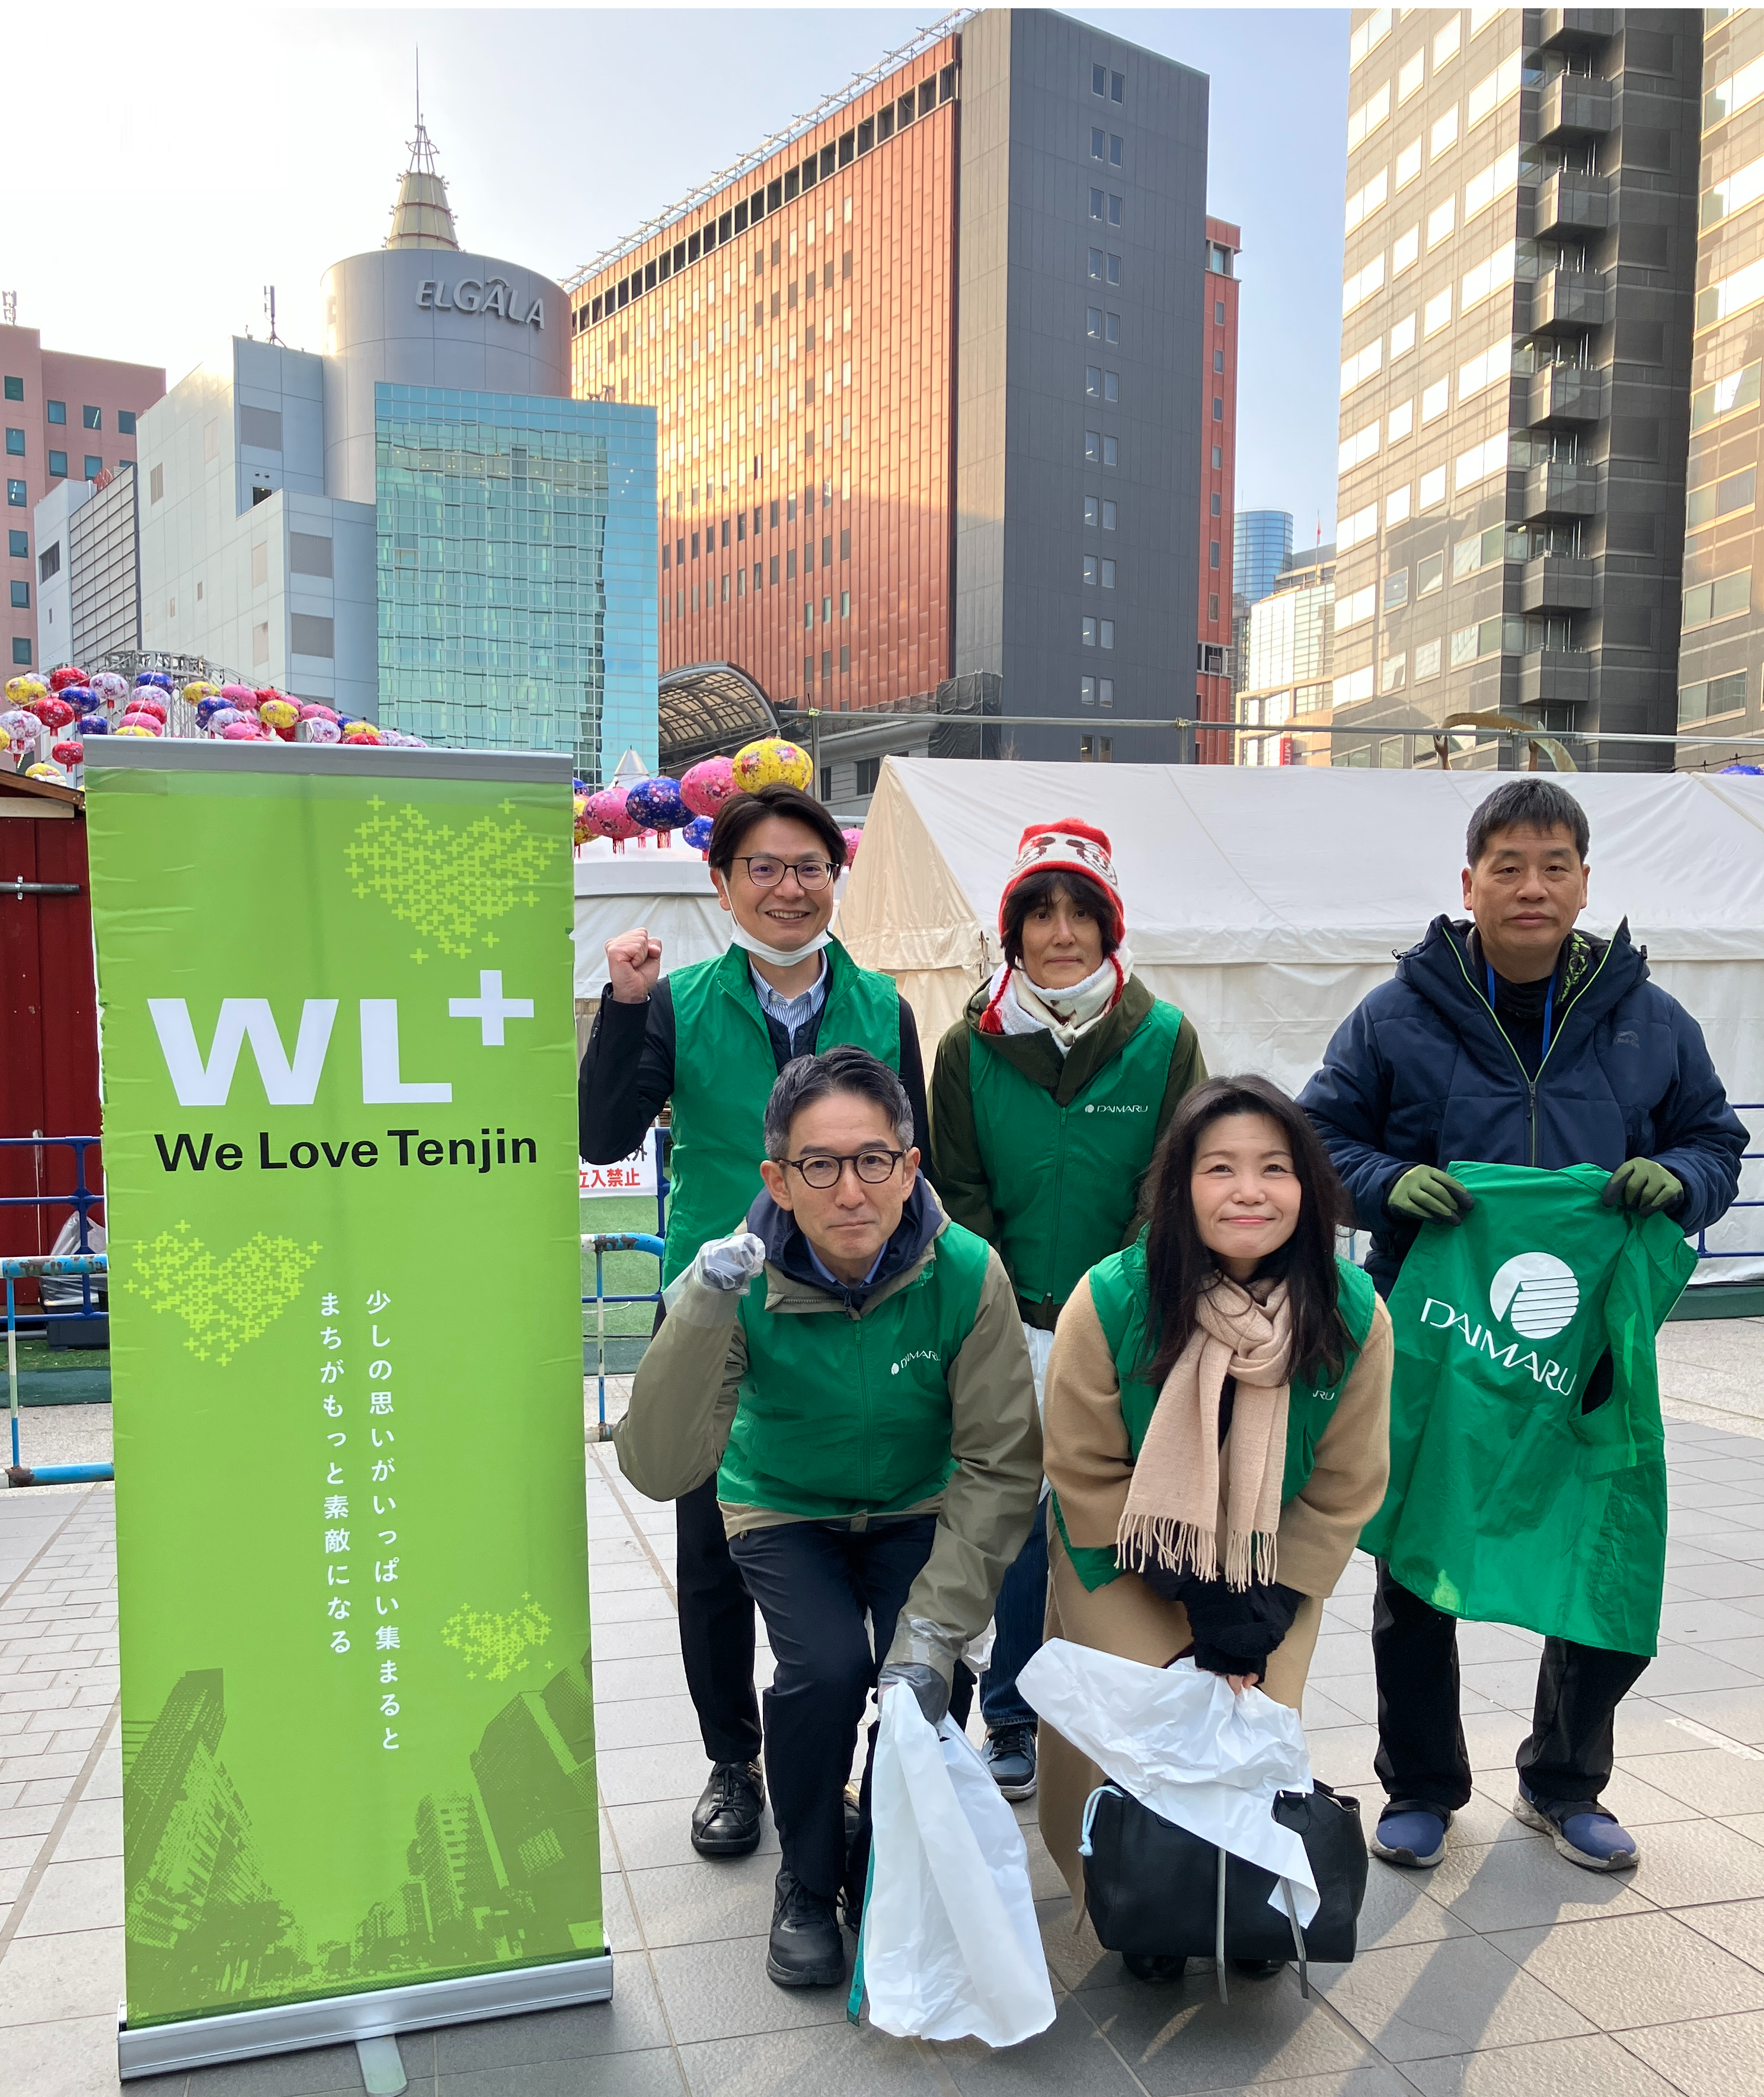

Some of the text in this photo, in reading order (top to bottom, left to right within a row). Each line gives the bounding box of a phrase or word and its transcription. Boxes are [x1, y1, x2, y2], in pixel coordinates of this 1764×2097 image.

[154, 1133, 243, 1172] We
[260, 1132, 378, 1169] Love
[387, 1128, 536, 1173] Tenjin
[1097, 1105, 1148, 1113] DAIMARU
[1420, 1297, 1577, 1396] DAIMARU
[320, 1292, 351, 1654] まちがもっと素敵になる
[366, 1290, 401, 1750] 少しの思いがいっぱい集まると
